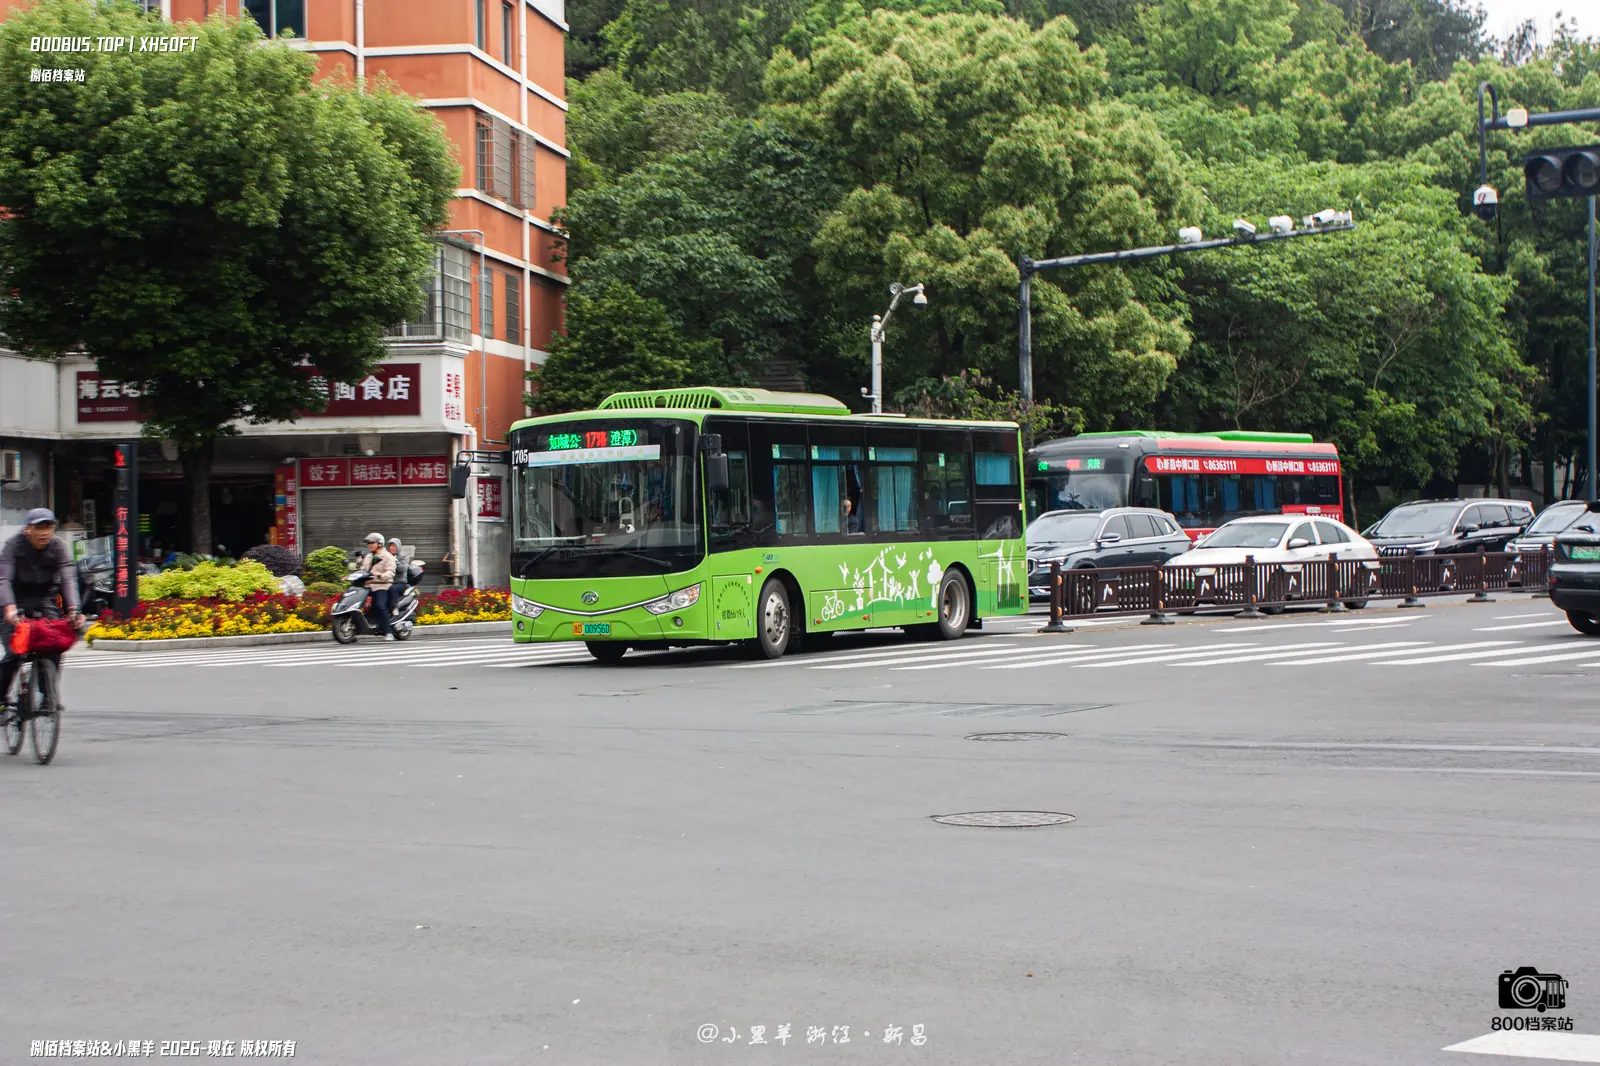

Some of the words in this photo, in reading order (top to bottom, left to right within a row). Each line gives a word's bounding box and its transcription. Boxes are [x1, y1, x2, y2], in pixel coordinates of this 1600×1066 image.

[511, 449, 529, 465] 1705
[1208, 459, 1237, 471] 86363111
[308, 464, 341, 482] 饺子
[403, 461, 449, 480] 小汤包
[115, 506, 129, 598] 行人禁止通行
